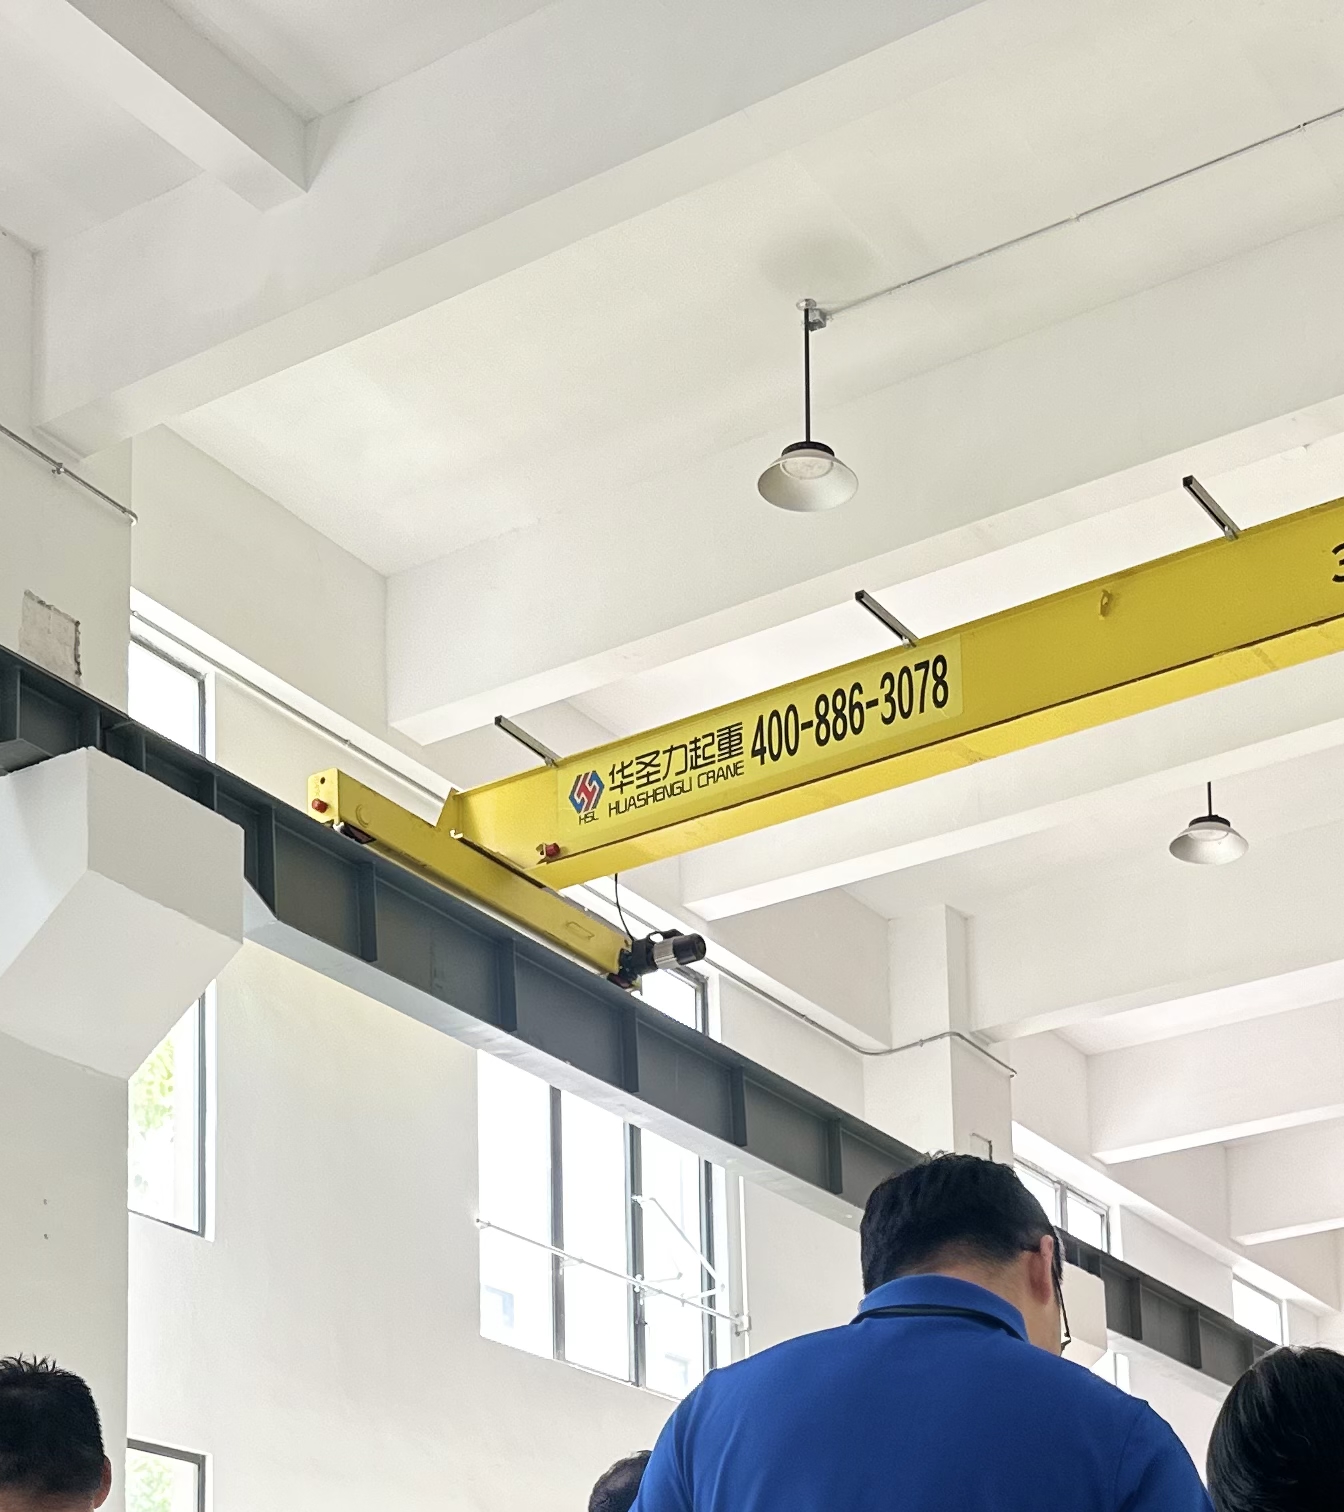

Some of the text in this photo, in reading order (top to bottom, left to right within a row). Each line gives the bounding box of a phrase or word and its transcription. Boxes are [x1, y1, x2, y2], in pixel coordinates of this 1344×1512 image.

[750, 653, 949, 767] 400-886-3078
[608, 721, 744, 795] 华圣力起重
[696, 759, 746, 790] CRANE
